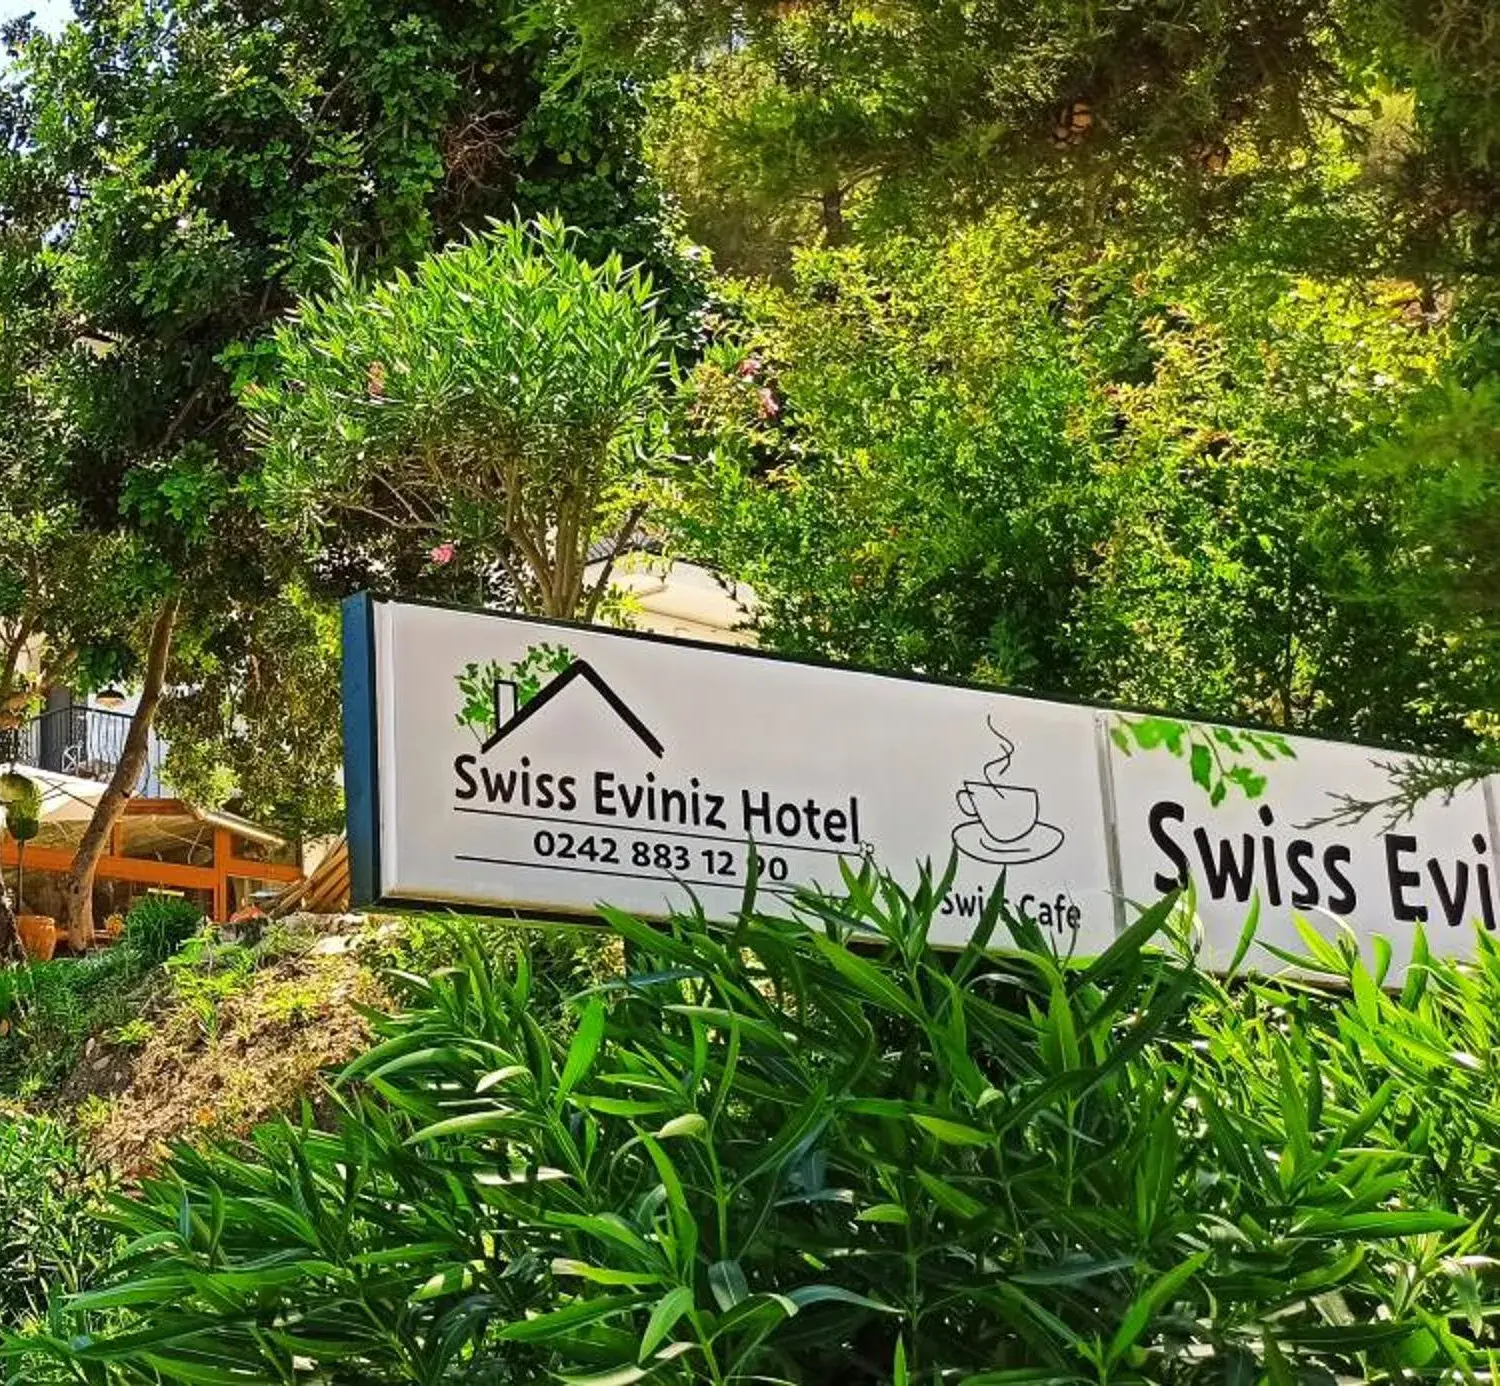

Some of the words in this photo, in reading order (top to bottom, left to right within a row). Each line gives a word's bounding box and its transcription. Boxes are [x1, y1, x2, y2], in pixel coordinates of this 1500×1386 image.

[454, 754, 577, 811] Swiss
[594, 771, 727, 830] Eviniz
[741, 789, 860, 844] Hotel
[533, 830, 620, 864] 0242
[631, 841, 691, 870] 883
[701, 849, 737, 876] 12
[1148, 801, 1358, 915] Swiss
[1384, 832, 1497, 931] Evi
[1020, 893, 1082, 934] Cafe
